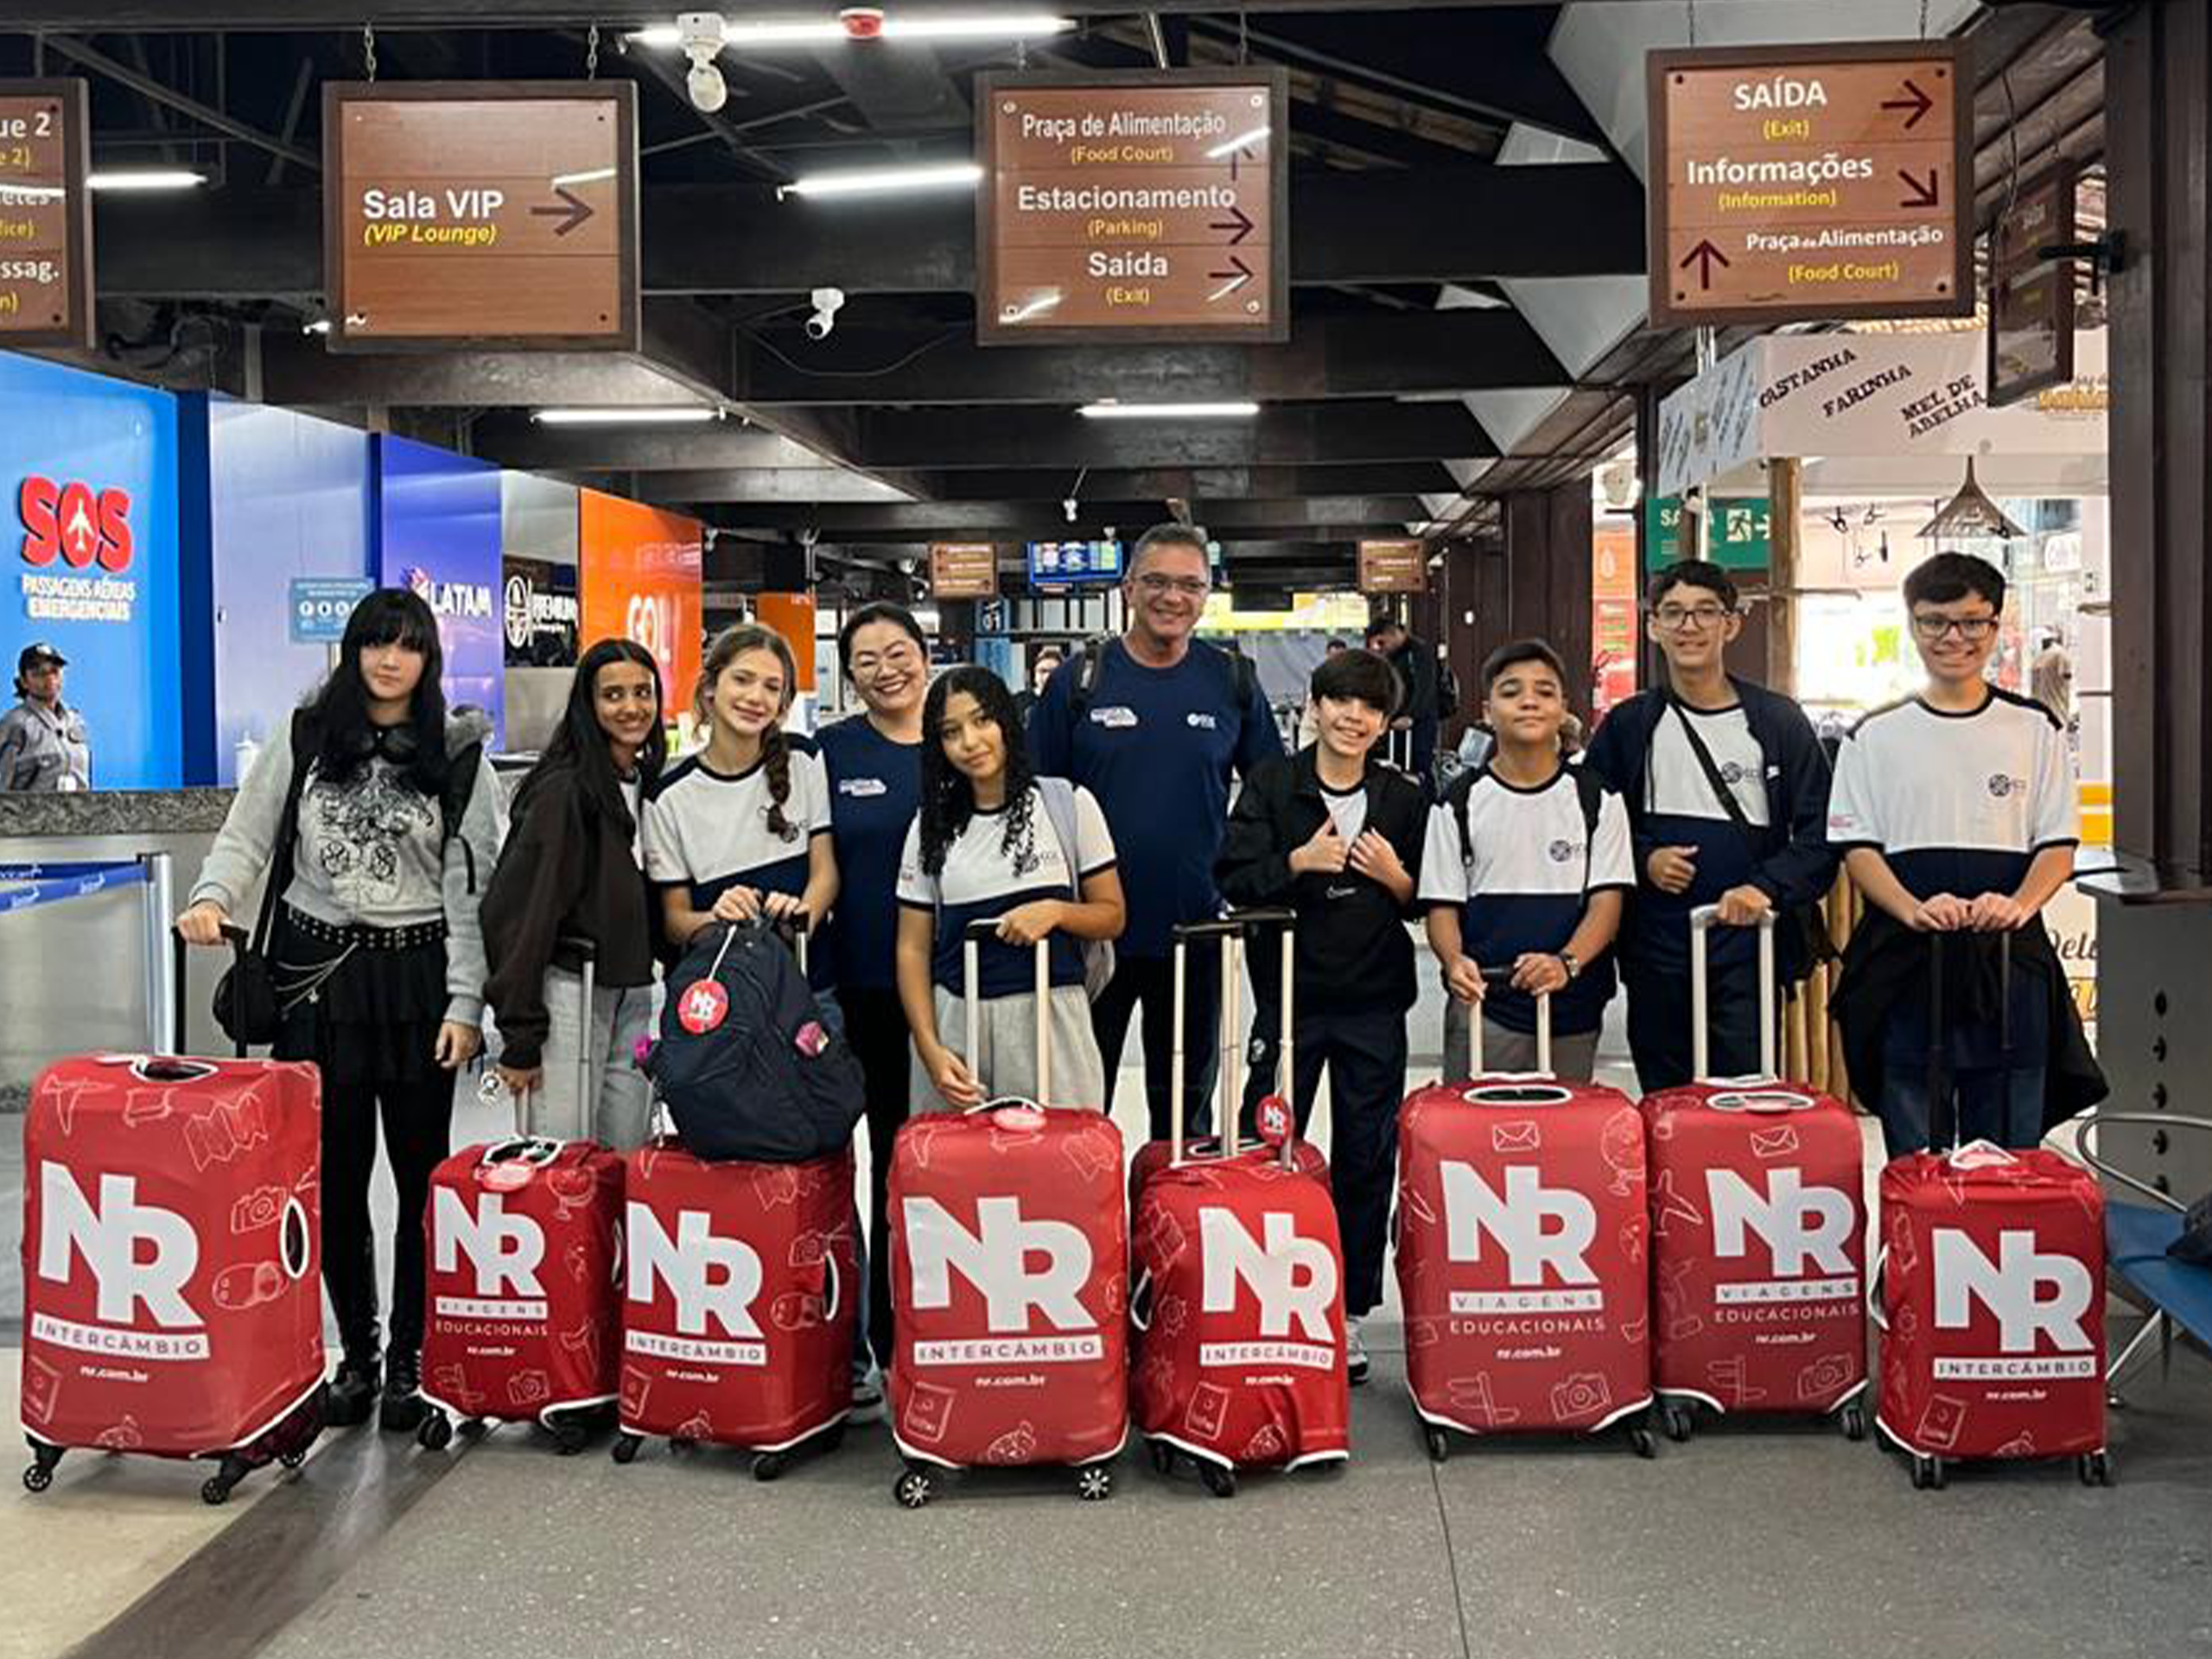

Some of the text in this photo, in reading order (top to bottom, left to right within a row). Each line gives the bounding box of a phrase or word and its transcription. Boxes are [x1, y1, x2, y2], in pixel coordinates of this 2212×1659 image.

[1733, 76, 1827, 111] SAÍDA
[35, 112, 51, 137] 2
[1022, 112, 1225, 143] Praça de Alimentação
[1763, 119, 1809, 139] (Exit)
[1071, 147, 1173, 165] (Food Court)
[1688, 153, 1873, 184] Informações
[363, 189, 504, 219] Sala VIP
[1018, 186, 1236, 211] Estacionamento
[1718, 188, 1837, 210] (Information)
[364, 223, 498, 246] (VIP Lounge)
[1087, 219, 1164, 238] (Parking)
[1746, 232, 1800, 252] Praça
[1817, 226, 1943, 247] Alimentação
[1089, 251, 1168, 276] Saída
[1788, 261, 1899, 283] (Food Court)
[1105, 288, 1150, 305] (Exit)
[1759, 348, 1857, 409] CASTANHA
[1822, 365, 1912, 417] FARINHA
[1901, 373, 1975, 421] MEL DE
[1909, 389, 1987, 438] ABELHA
[18, 476, 132, 573] SOS
[430, 582, 493, 619] LATAM
[1440, 1160, 1599, 1286] NR
[1705, 1167, 1855, 1276] NR
[39, 1160, 206, 1328] NR
[434, 1185, 547, 1296] NR
[626, 1201, 765, 1338] NR
[903, 1197, 1099, 1332] NR
[1198, 1207, 1336, 1343] NR
[1456, 1295, 1597, 1309] VIAGENS
[1932, 1229, 2094, 1351] NR
[435, 1319, 548, 1336] EDUCACIONAIS
[1450, 1318, 1605, 1334] EDUCACIONAIS
[1715, 1305, 1858, 1323] EDUCACIONAIS
